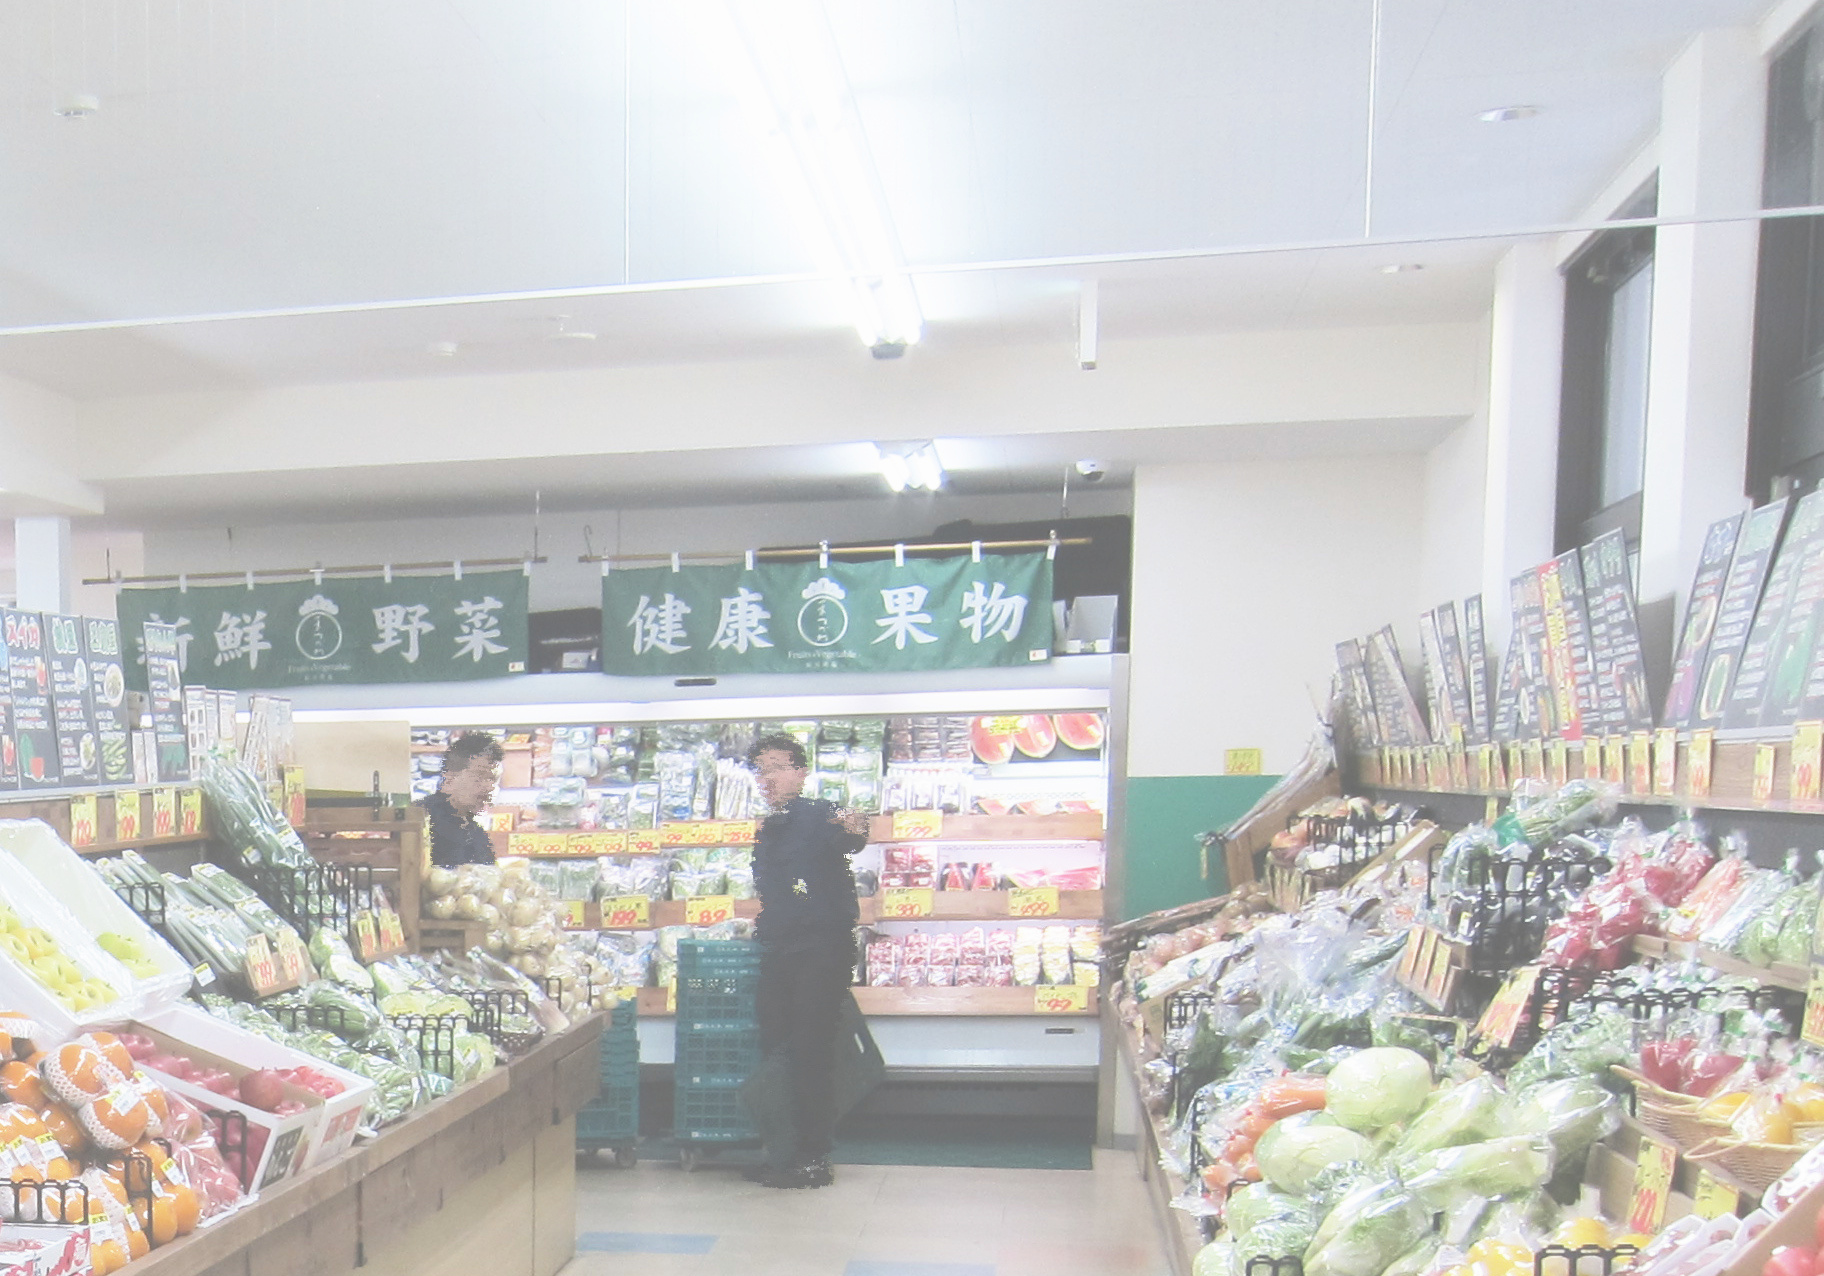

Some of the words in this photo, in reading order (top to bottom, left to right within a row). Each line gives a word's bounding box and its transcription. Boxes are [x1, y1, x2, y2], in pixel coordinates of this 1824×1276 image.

[373, 596, 509, 663] 野菜
[628, 587, 774, 654] 健康
[872, 582, 1027, 650] 果物
